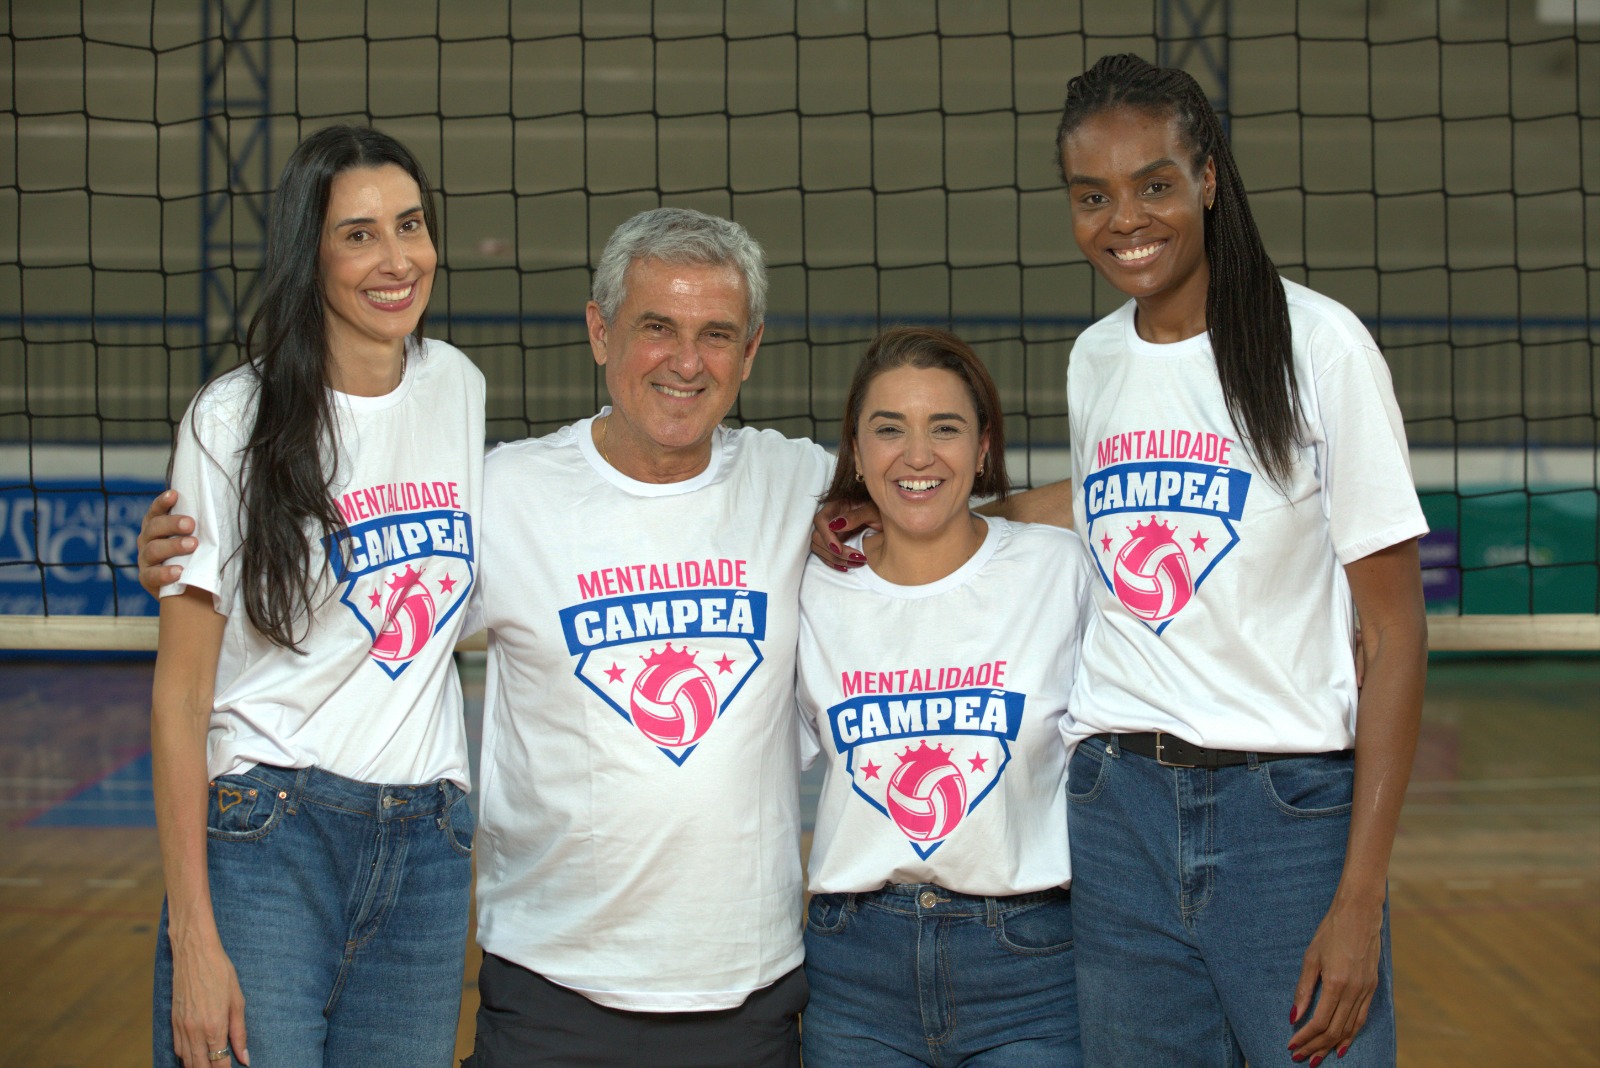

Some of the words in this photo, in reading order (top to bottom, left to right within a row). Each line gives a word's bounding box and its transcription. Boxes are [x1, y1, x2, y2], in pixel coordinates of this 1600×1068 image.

[1097, 429, 1234, 469] MENTALIDADE
[333, 481, 461, 526] MENTALIDADE
[1089, 468, 1230, 515] CAMPEÃ
[339, 512, 470, 573] CAMPEÃ
[577, 558, 748, 600] MENTALIDADE
[574, 590, 755, 647] CAMPEÃ
[841, 660, 1007, 698] MENTALIDADE
[837, 690, 1009, 744] CAMPEÃ
